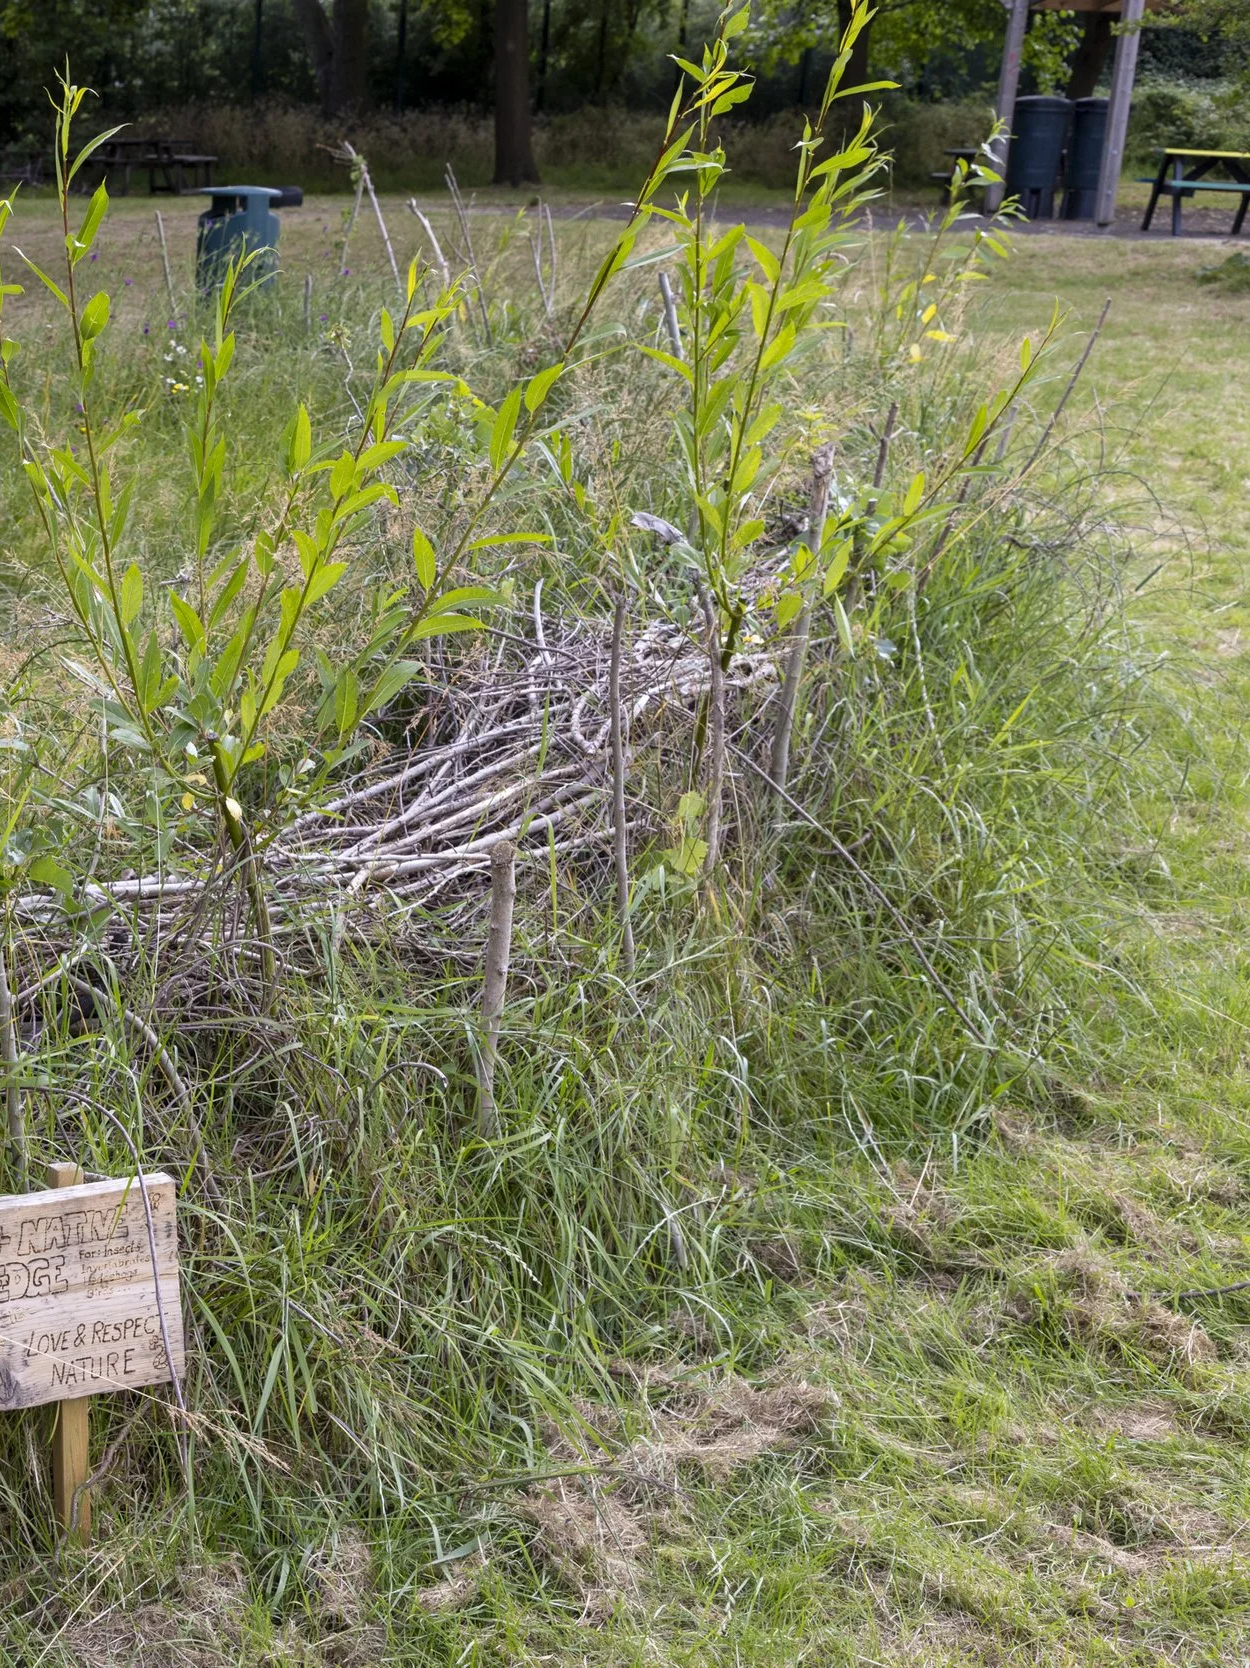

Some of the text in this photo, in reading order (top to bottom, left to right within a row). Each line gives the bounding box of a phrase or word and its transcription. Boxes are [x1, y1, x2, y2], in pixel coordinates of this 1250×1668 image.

[17, 1203, 128, 1256] NATIVE
[103, 1240, 143, 1258] Insects
[26, 1330, 71, 1358] LOVE
[73, 1323, 87, 1348] &
[50, 1348, 136, 1387] NATURE
